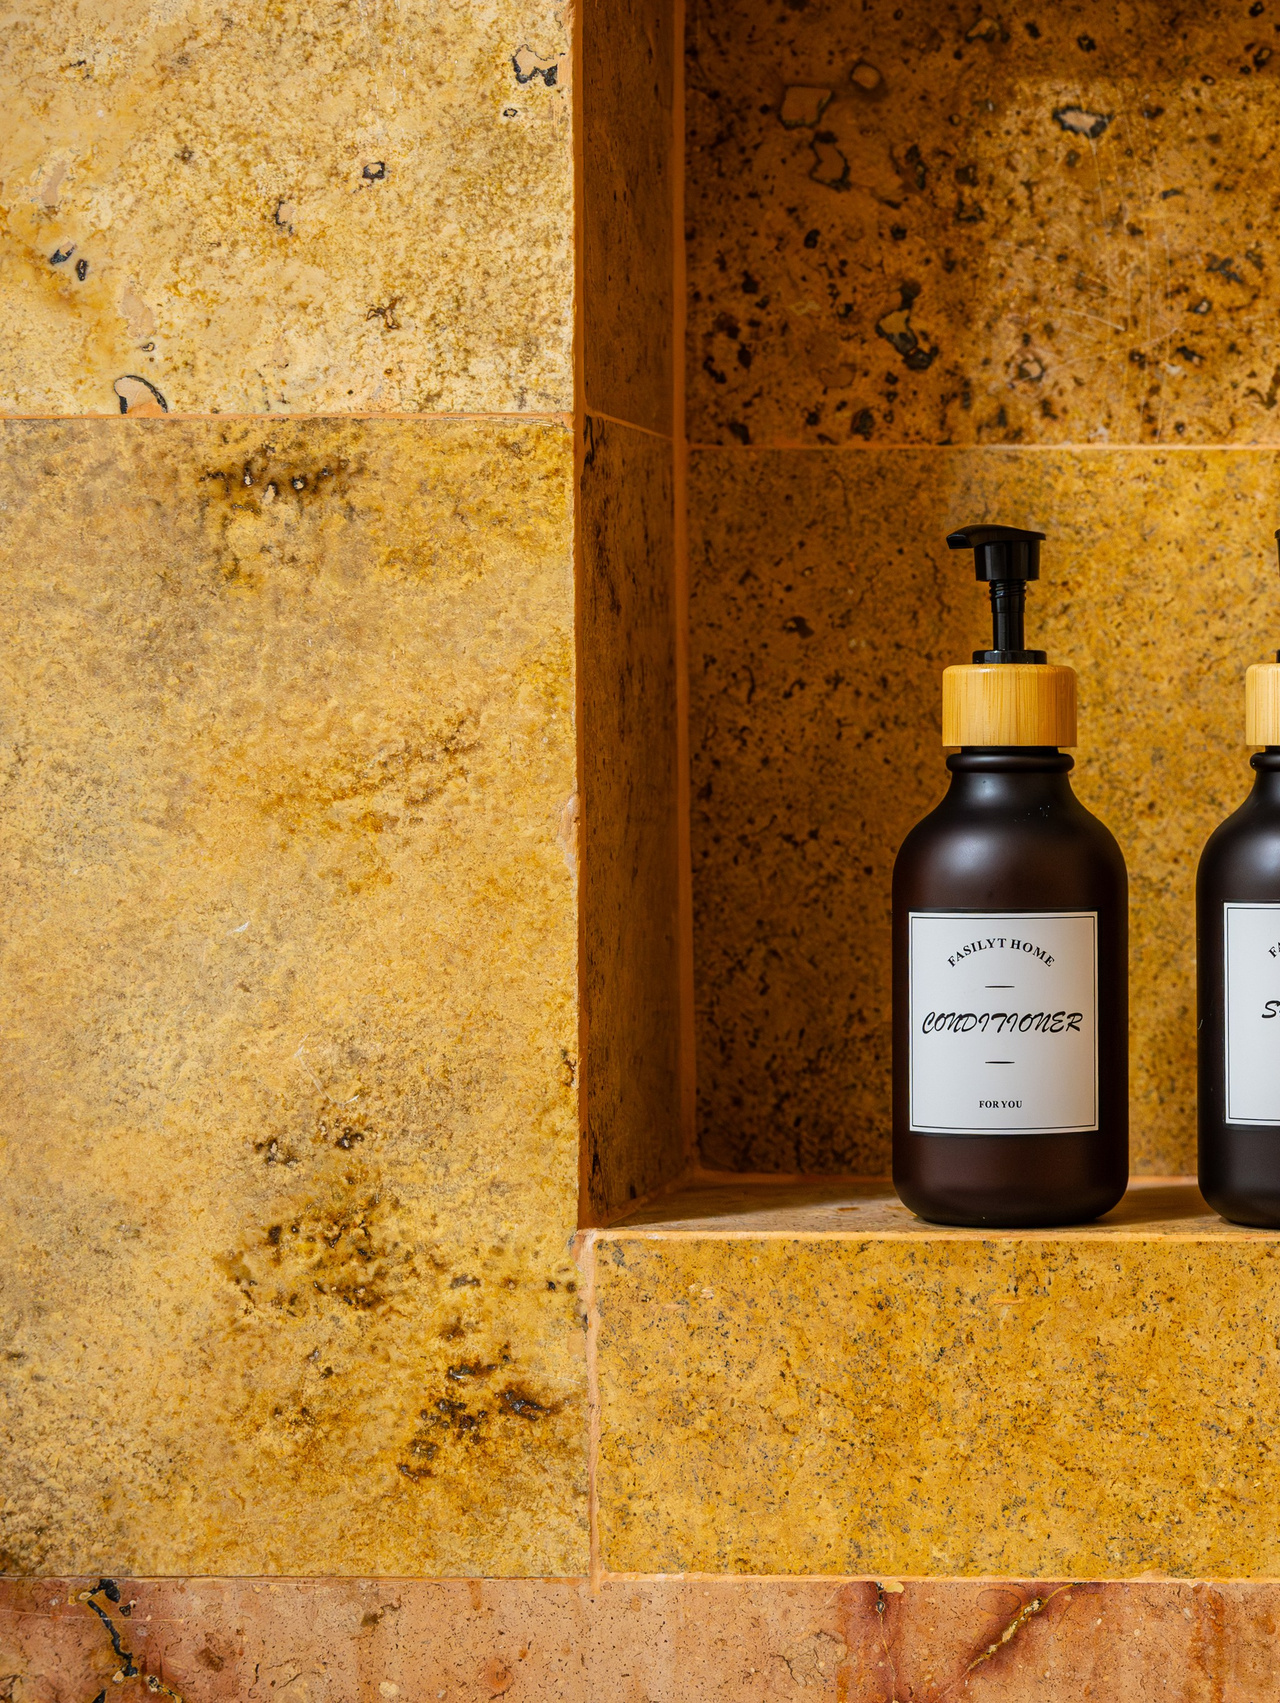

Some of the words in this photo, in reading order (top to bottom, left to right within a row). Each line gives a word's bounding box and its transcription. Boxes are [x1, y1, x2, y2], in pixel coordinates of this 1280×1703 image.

[947, 937, 1007, 968] FASILYT
[1010, 938, 1055, 968] HOME
[921, 1011, 1084, 1034] CONDITIONER
[979, 1100, 1000, 1109] FOR
[1001, 1100, 1023, 1109] YOU
